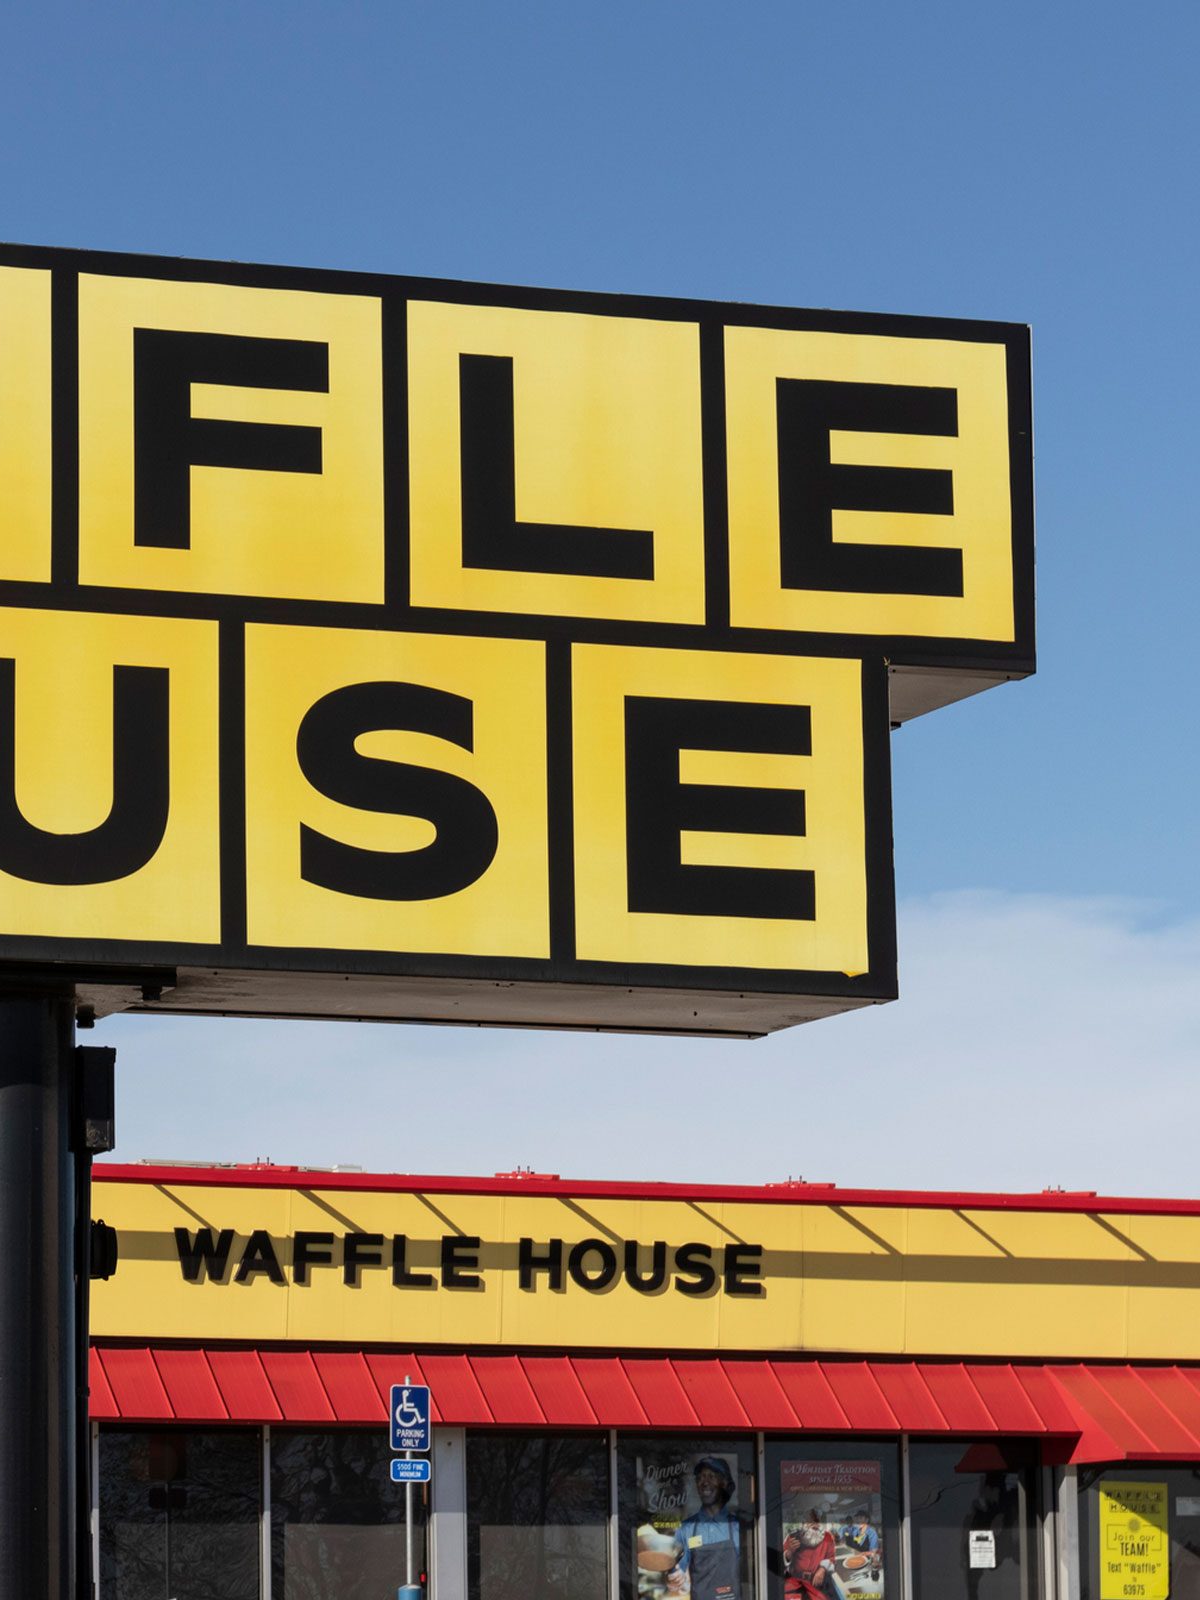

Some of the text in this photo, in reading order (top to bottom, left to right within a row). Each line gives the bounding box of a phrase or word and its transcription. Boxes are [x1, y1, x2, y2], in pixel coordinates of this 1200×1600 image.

[174, 1227, 763, 1297] WAFFLE HOUSE
[396, 1429, 425, 1439] PARKING
[401, 1439, 420, 1447] ONLY
[645, 1460, 689, 1481] Dinner
[833, 1474, 853, 1484] 1955
[1110, 1503, 1157, 1513] HOUSE
[1113, 1533, 1155, 1542] Join our
[1120, 1542, 1149, 1557] TEAM!
[1107, 1562, 1122, 1573] Text
